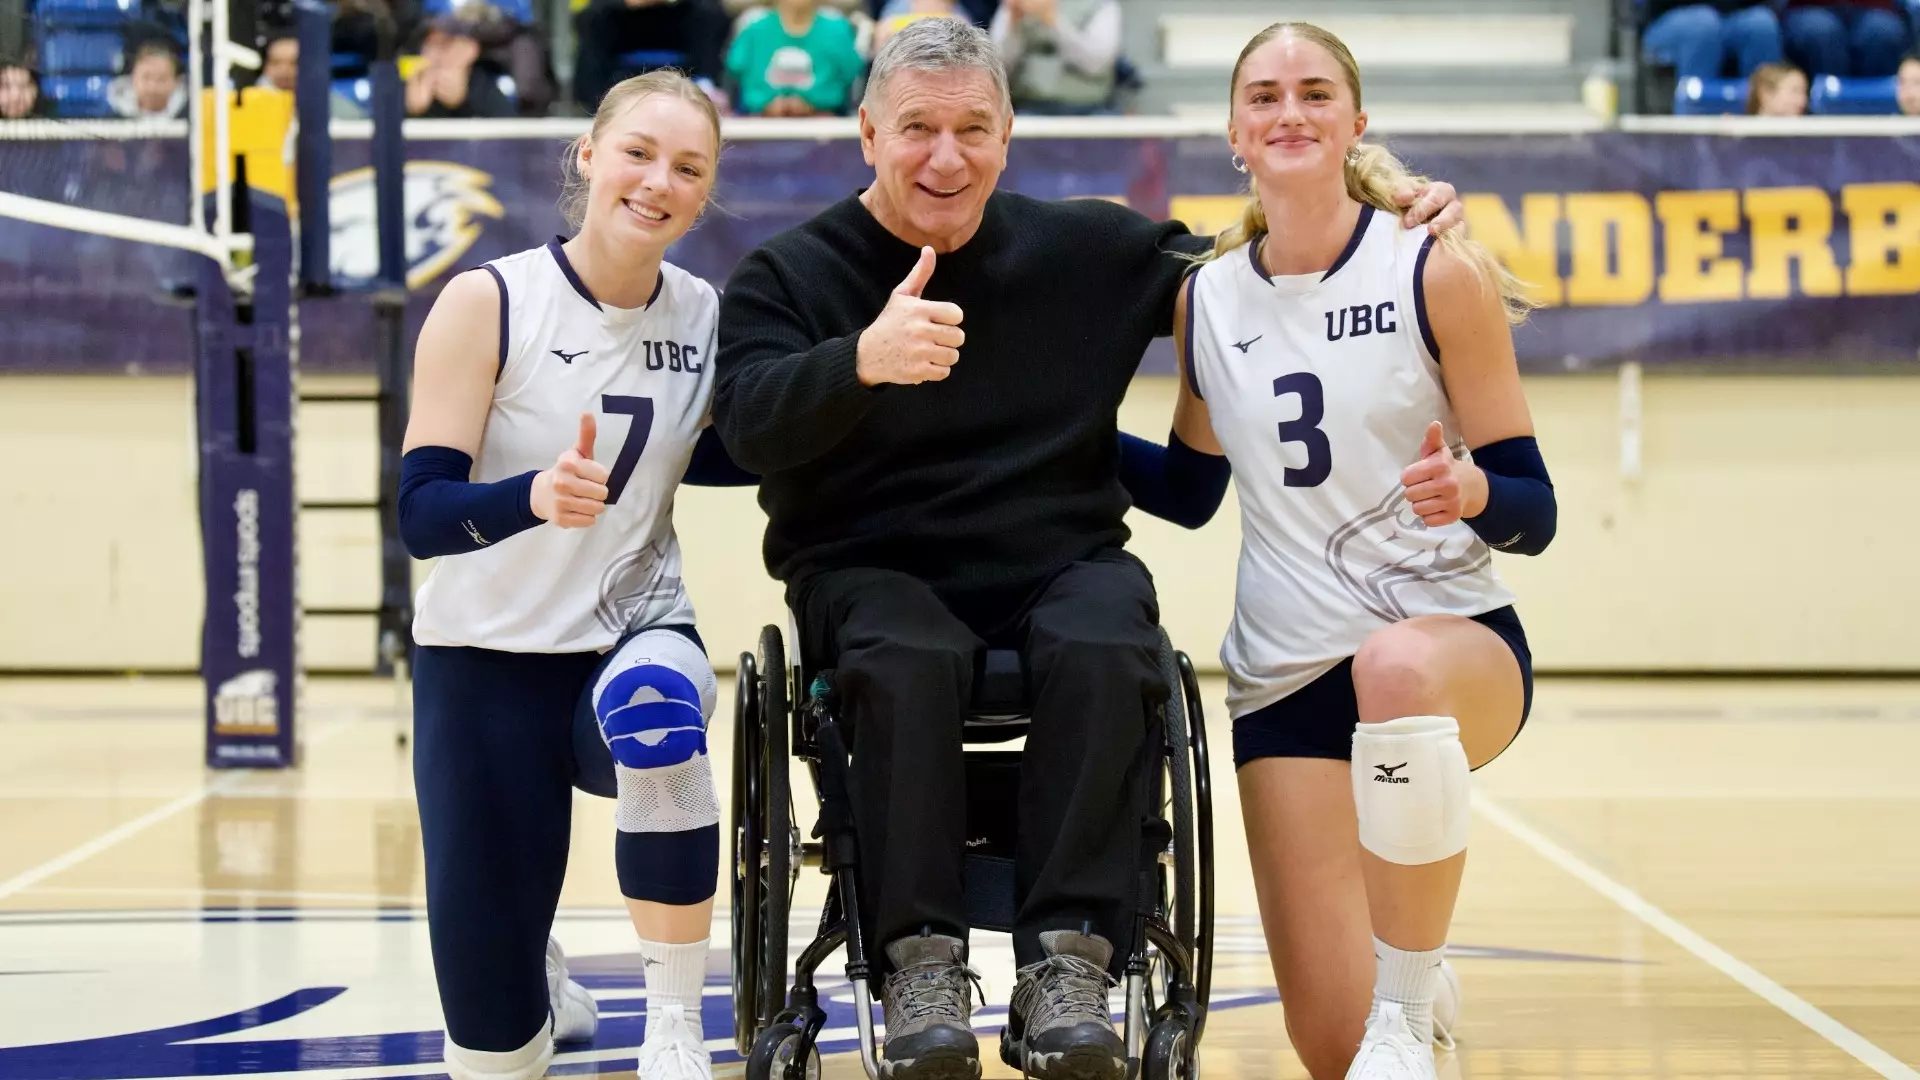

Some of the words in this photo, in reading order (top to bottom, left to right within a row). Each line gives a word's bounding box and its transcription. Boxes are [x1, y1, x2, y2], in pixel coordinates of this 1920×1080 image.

[1461, 182, 1920, 306] NDERB
[642, 340, 702, 373] UBC
[1325, 301, 1396, 341] UBC
[601, 394, 654, 505] 7
[1273, 372, 1332, 488] 3
